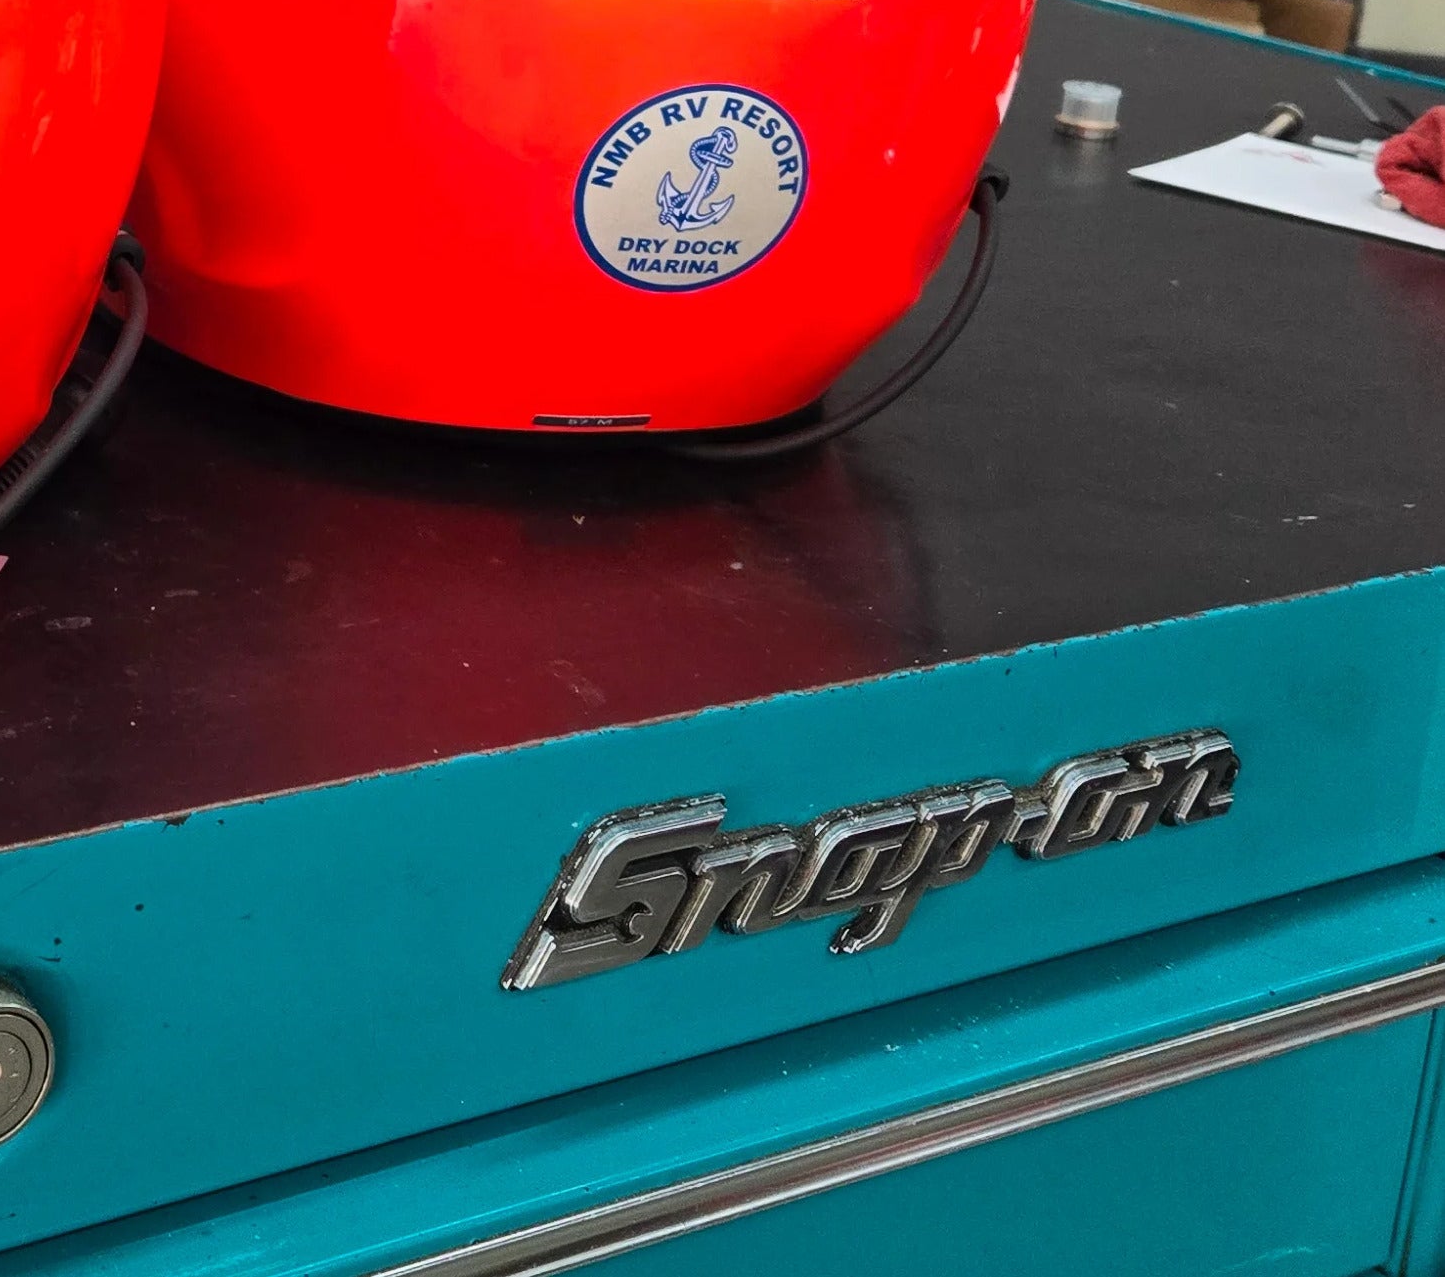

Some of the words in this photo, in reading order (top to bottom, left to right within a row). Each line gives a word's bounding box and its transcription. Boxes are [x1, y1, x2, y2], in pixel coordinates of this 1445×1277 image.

[590, 120, 652, 189] NMB
[659, 95, 709, 127] RV
[719, 96, 801, 196] RESORT
[617, 236, 669, 254] DRY
[673, 239, 742, 255] DOCK
[626, 257, 720, 275] MARINA
[500, 727, 1242, 992] Snap-on
